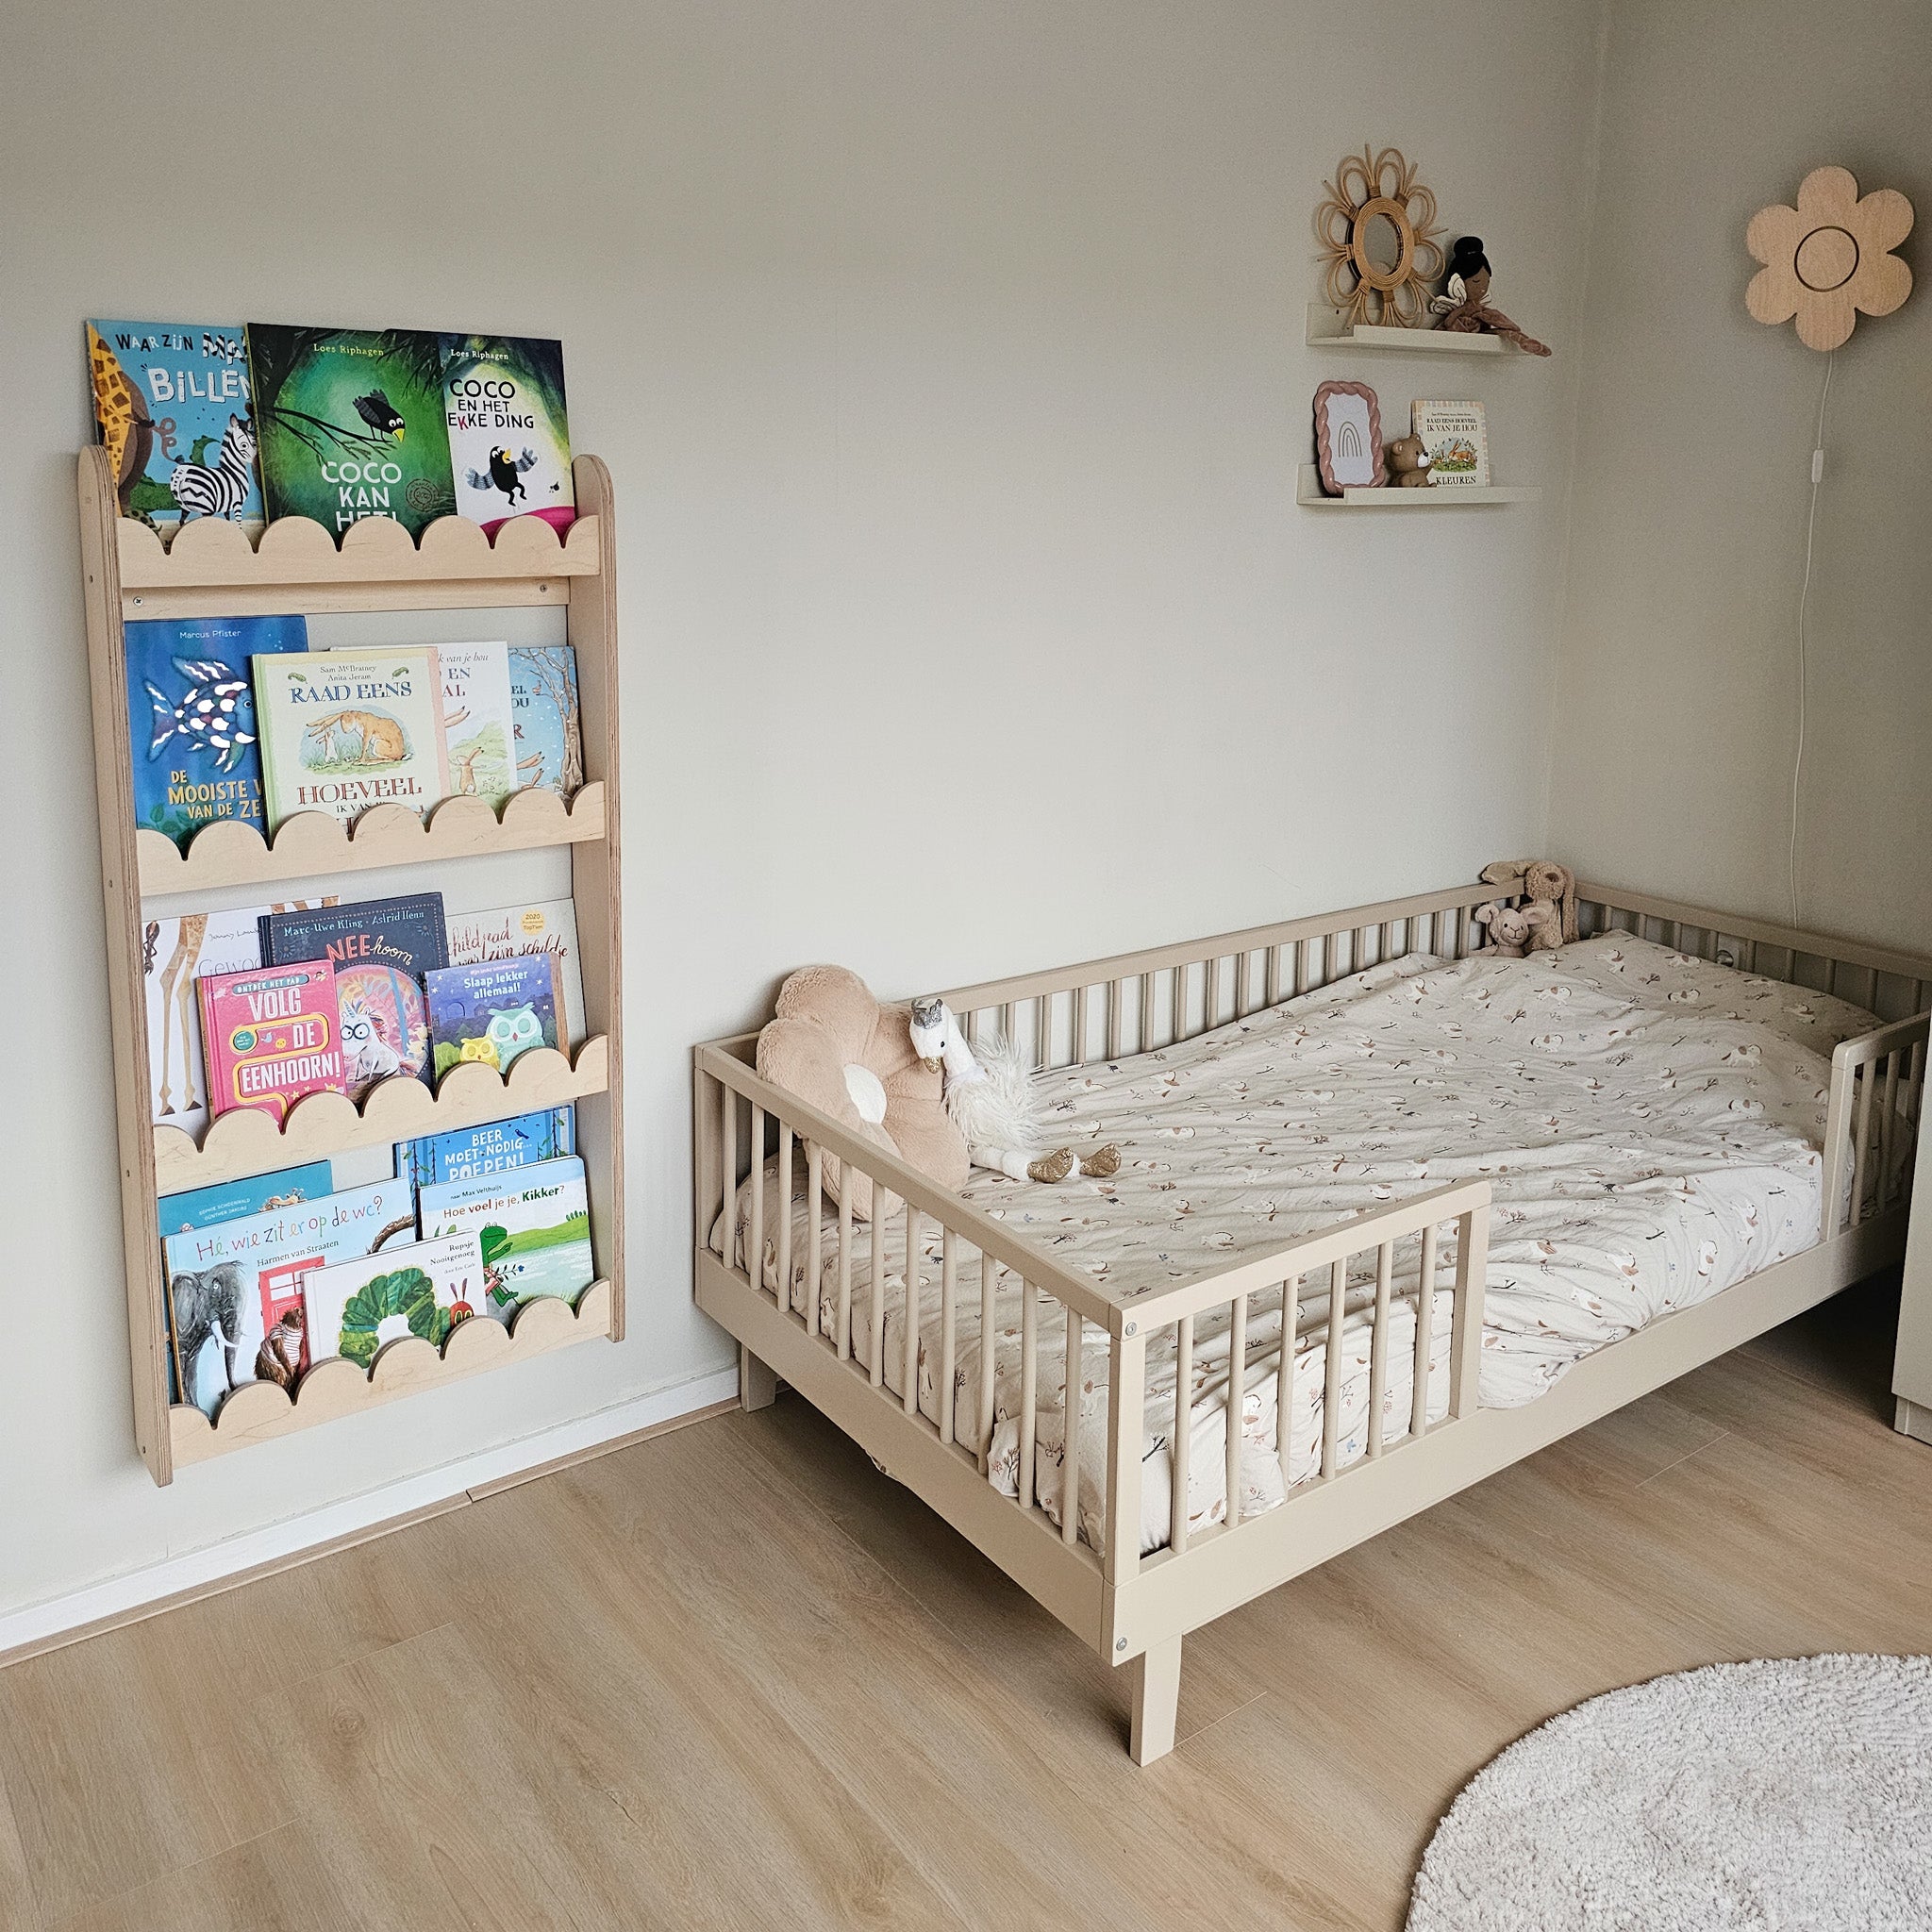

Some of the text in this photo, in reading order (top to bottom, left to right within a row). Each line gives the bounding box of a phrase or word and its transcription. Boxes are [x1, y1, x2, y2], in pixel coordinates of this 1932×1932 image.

[115, 333, 159, 353] WAAR
[313, 342, 384, 358] Loes Riphagen
[450, 349, 509, 361] Loes Riphagen
[449, 378, 516, 399] COCO
[458, 399, 510, 412] EN HET
[447, 412, 534, 430] EKKE DING
[321, 461, 403, 484] COCO
[1435, 475, 1477, 485] KLEUREN
[339, 486, 391, 508] KAN
[212, 629, 242, 638] Pfister
[448, 667, 471, 679] EN
[289, 681, 413, 704] RAAD EENS
[171, 770, 187, 784] DE
[167, 780, 248, 806] MOOISTE
[297, 776, 423, 806] HOEVEEL
[187, 804, 213, 820] VAN
[217, 803, 234, 816] DE
[336, 805, 348, 813] IK
[284, 924, 335, 937] Marc-Uwe
[337, 920, 363, 929] Kling
[372, 912, 401, 925] Astrid
[448, 916, 513, 960] hildpad
[237, 981, 267, 993] ONTDEK
[269, 978, 286, 988] HET
[463, 970, 528, 989] Slaap lekker
[474, 983, 522, 999] allemaal!
[248, 987, 302, 1022] VOLG
[292, 1022, 316, 1049] DE
[241, 1051, 341, 1093] EENHOORN!
[472, 1128, 503, 1147] BEER
[444, 1147, 478, 1167] MOET
[461, 1190, 475, 1198] Max
[475, 1184, 503, 1194] Velthuijs
[443, 1185, 566, 1219] Hoe voel je je, Kikker?
[196, 1195, 383, 1262] Hé, wie zit er op de wc?
[257, 1239, 340, 1268] Harmen van Straaten
[449, 1241, 475, 1252] Rupsje
[429, 1249, 475, 1266] Nooitgenoeg
